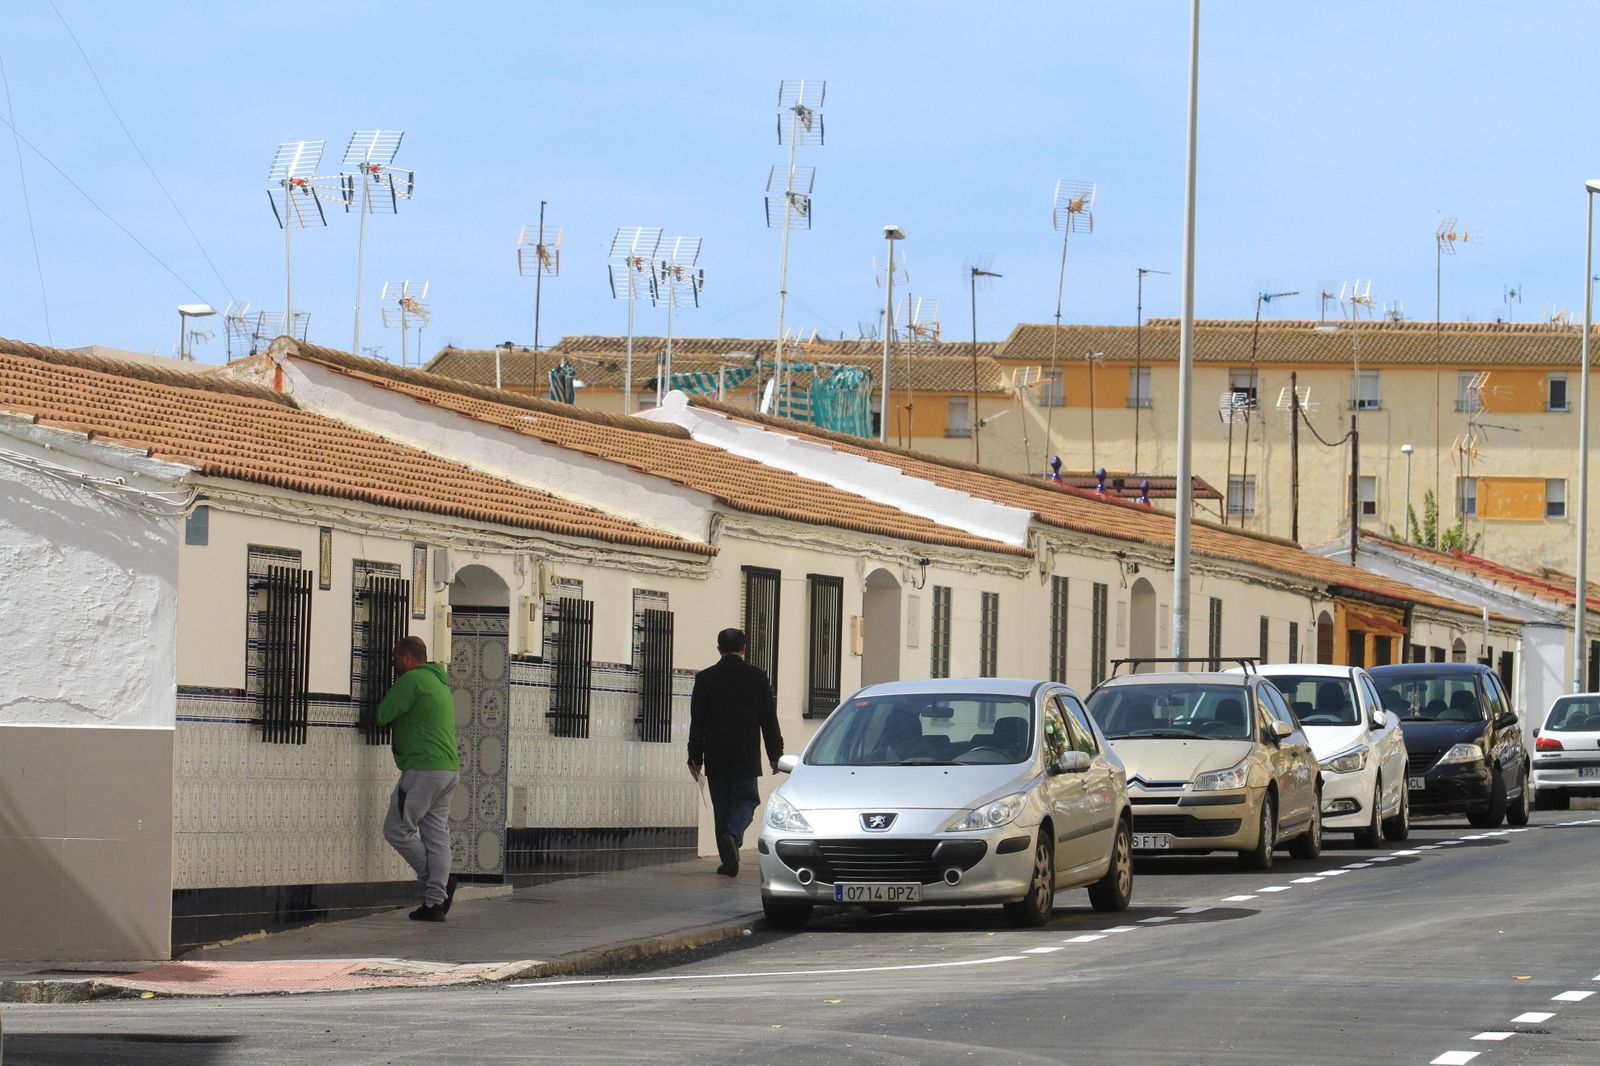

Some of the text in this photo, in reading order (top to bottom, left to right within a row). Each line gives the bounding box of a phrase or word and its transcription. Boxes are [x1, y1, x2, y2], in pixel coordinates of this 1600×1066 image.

[1408, 779, 1422, 788] CL
[1143, 836, 1167, 847] FTJ
[847, 887, 882, 900] 0714
[888, 887, 914, 900] DPZ
